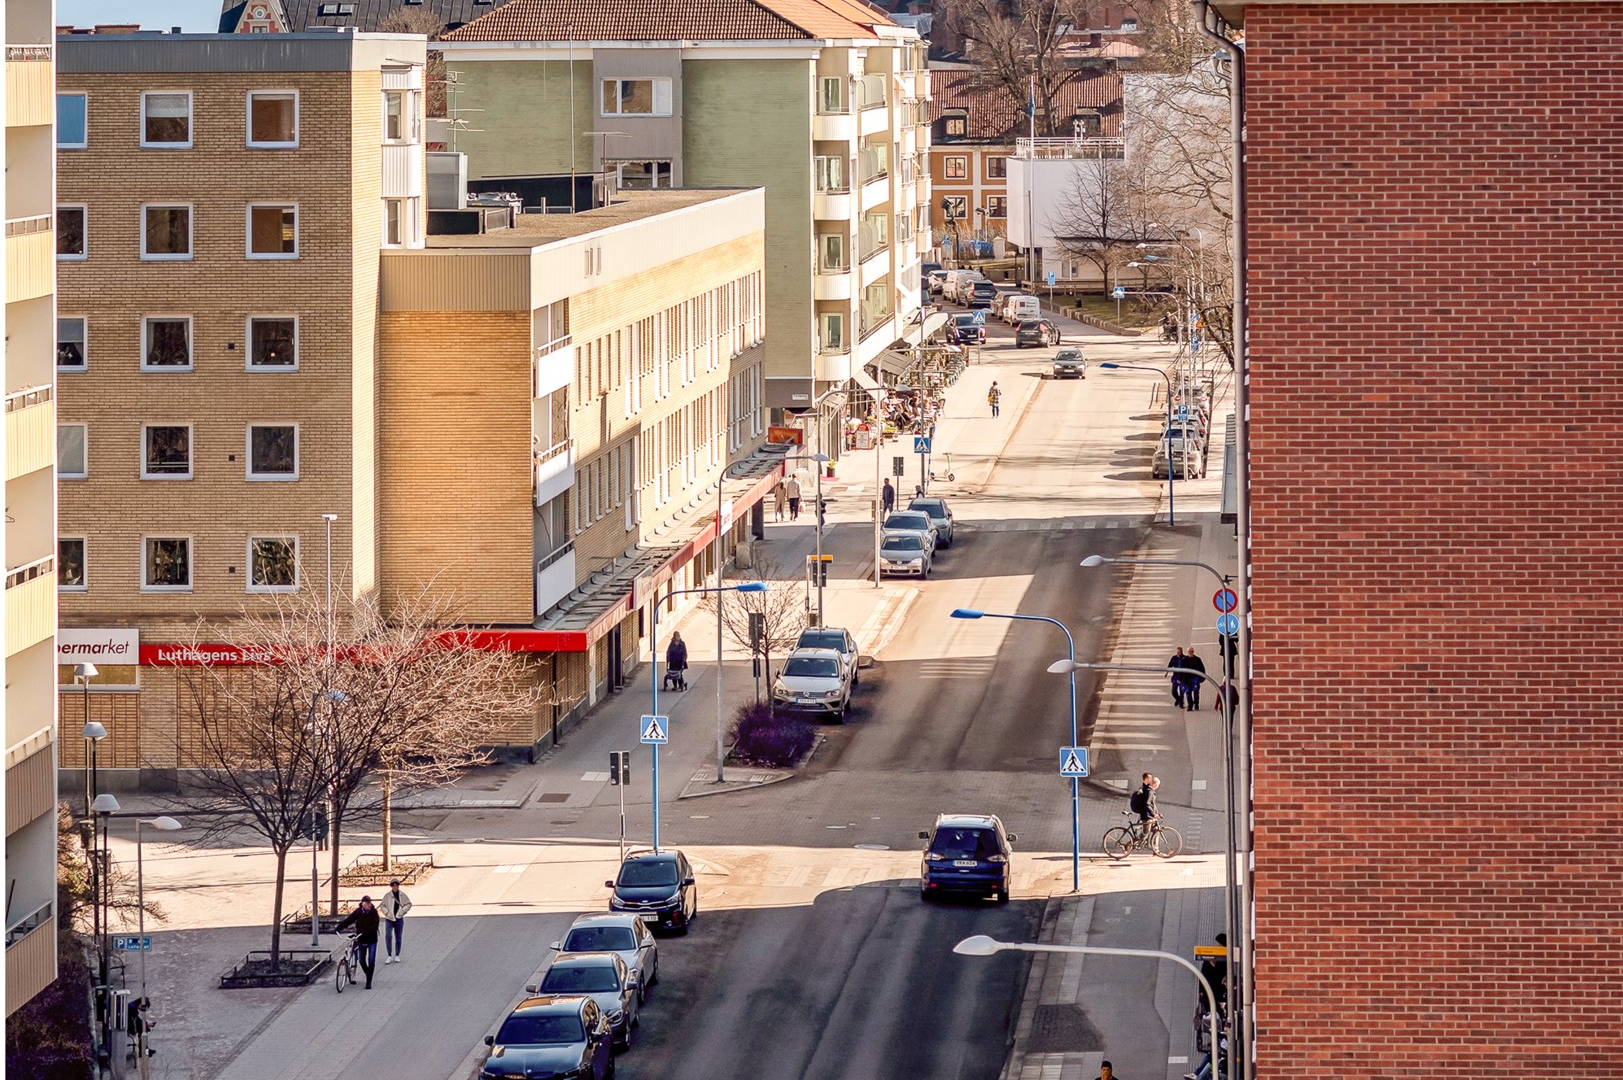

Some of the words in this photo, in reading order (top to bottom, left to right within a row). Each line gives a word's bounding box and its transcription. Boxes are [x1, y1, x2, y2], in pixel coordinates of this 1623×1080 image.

[1181, 406, 1187, 414] P
[158, 649, 237, 663] Luthagens
[118, 939, 124, 948] P
